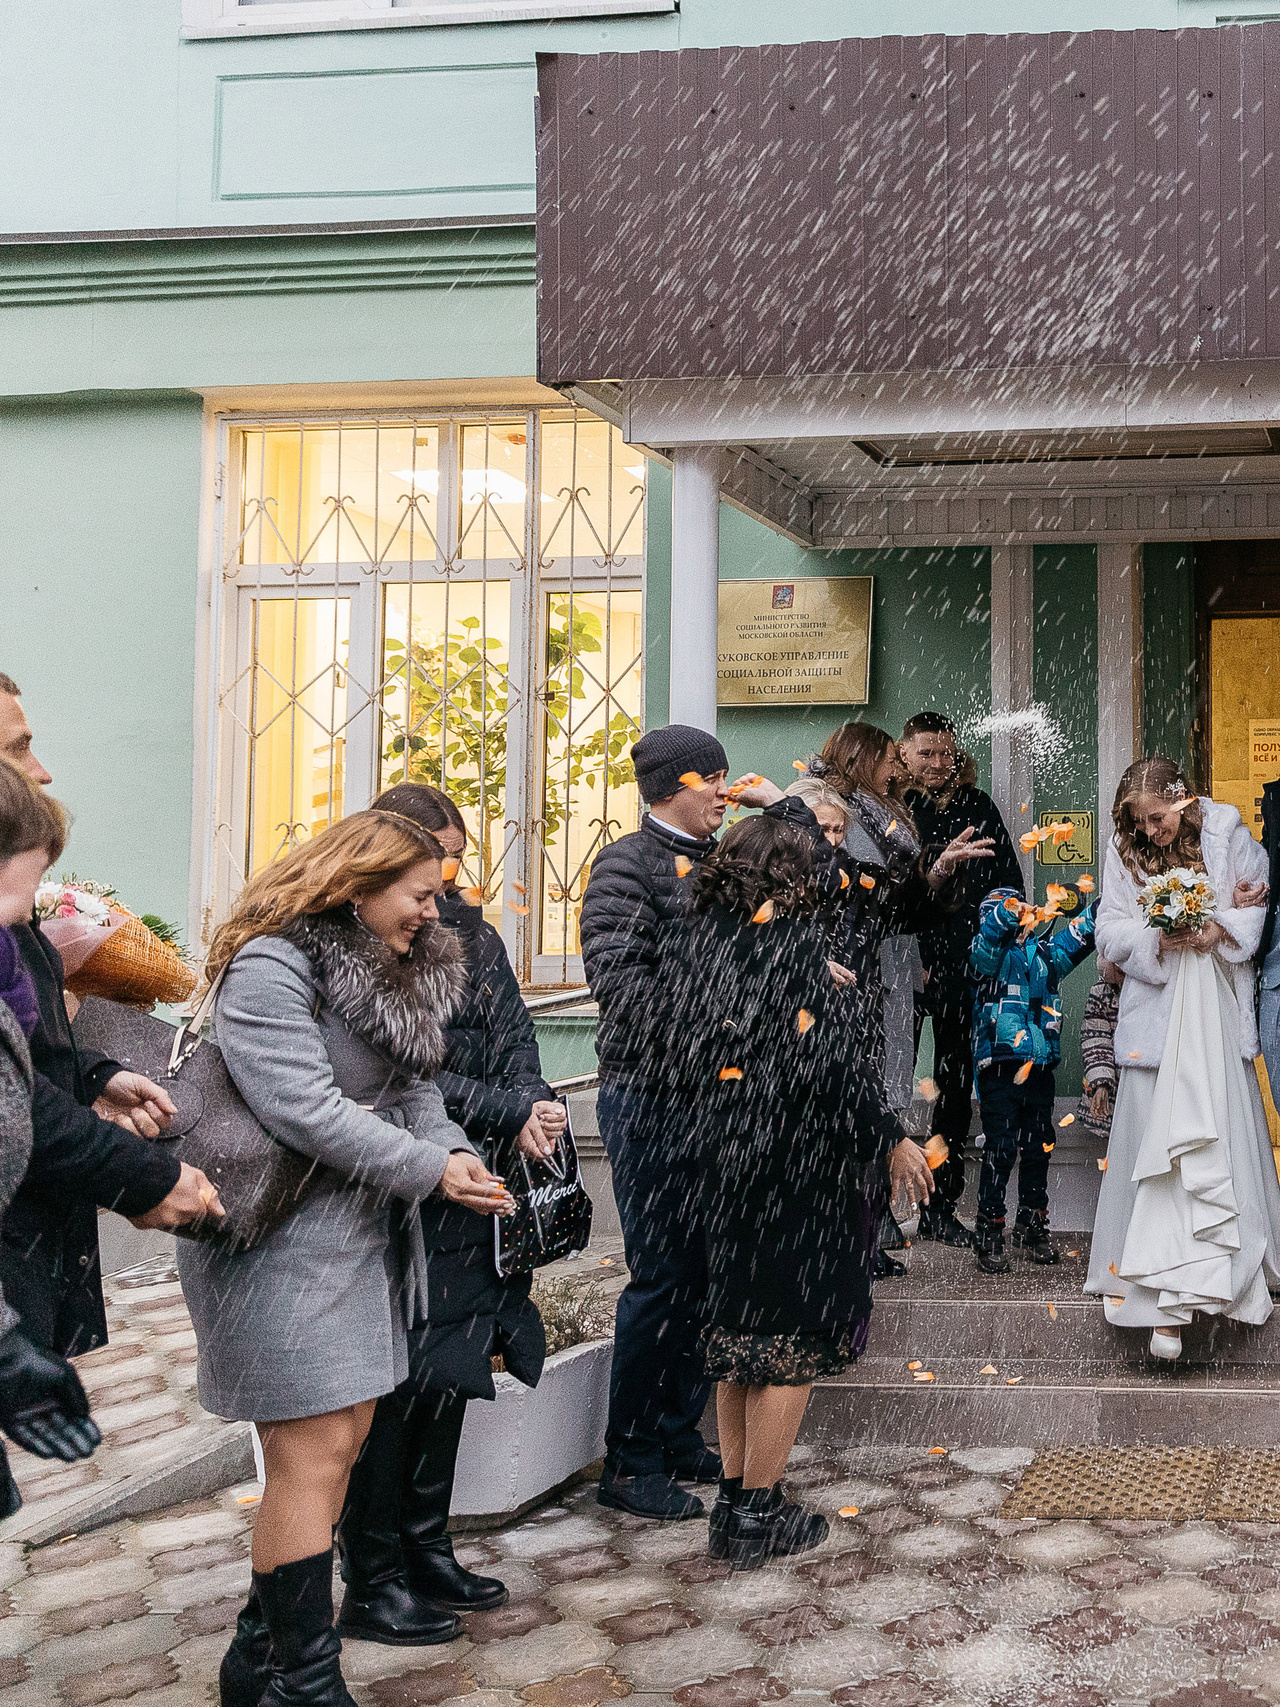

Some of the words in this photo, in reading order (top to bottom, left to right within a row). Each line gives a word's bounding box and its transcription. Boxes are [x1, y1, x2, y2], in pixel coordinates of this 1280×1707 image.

[753, 613, 810, 622] МИНИСТЕРСТВО
[735, 623, 790, 631] СОЦИАЛЬНОГО
[790, 621, 827, 630] РАЗВИТИЯ
[738, 632, 789, 640] МОСКОВСКОЙ
[789, 631, 824, 639] ОБЛАСТИ
[780, 651, 849, 661] УПРАВЛЕНИЕ
[717, 667, 792, 680] СОЦИАЛЬНОЙ
[795, 667, 842, 678] ЗАЩИТЫ
[747, 684, 812, 694] НАСЕЛЕНИЯ
[1253, 753, 1269, 762] ВСЁ
[528, 1179, 578, 1208] Merci
